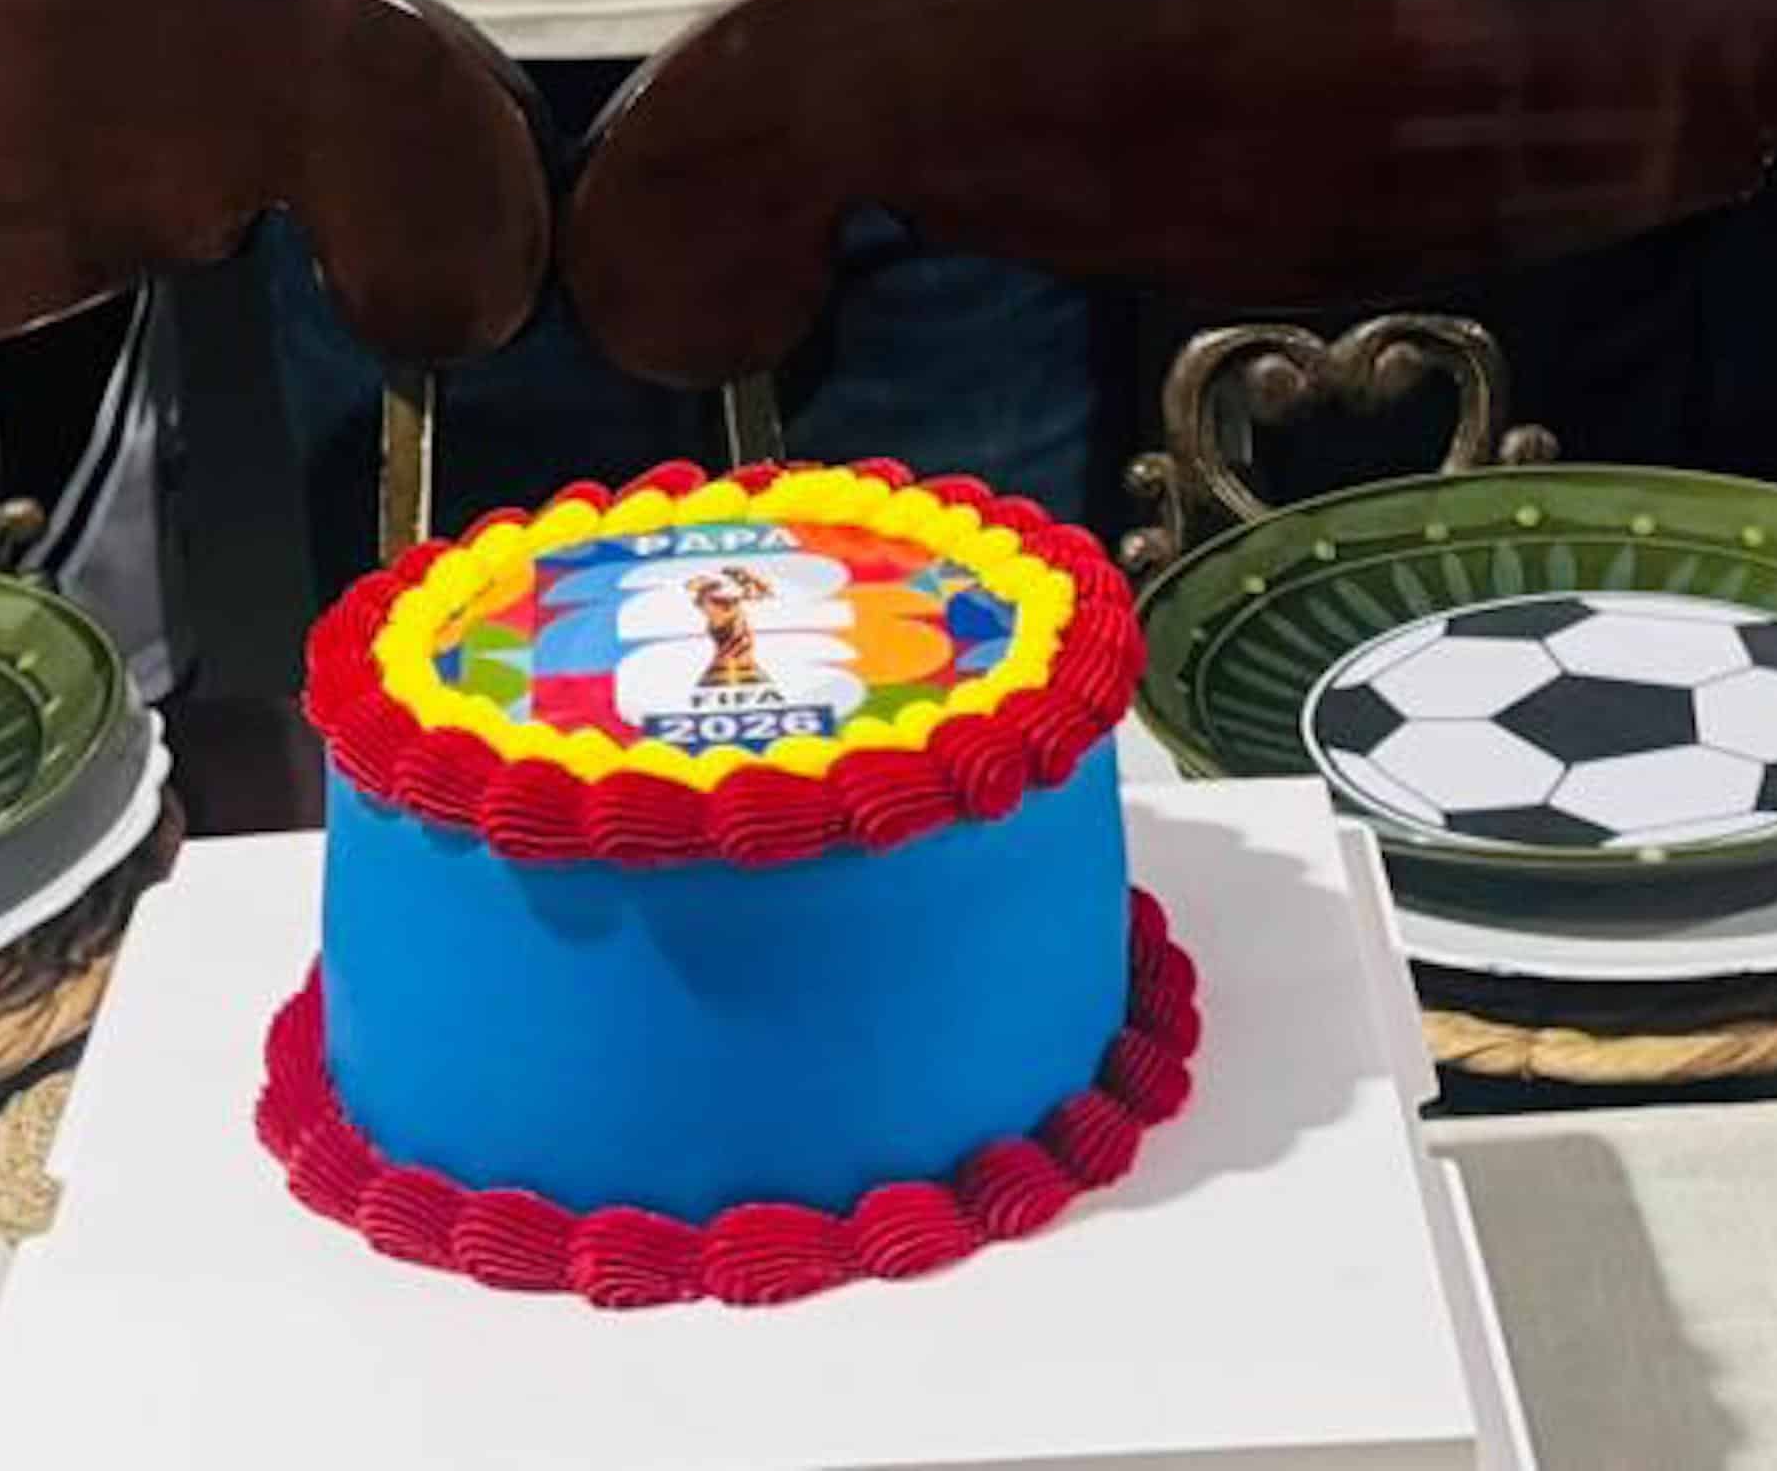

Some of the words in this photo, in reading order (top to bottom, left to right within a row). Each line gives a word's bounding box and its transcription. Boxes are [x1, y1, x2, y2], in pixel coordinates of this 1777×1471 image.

[634, 526, 802, 556] PAPA
[690, 689, 786, 708] FIFA
[655, 709, 824, 745] 2026
